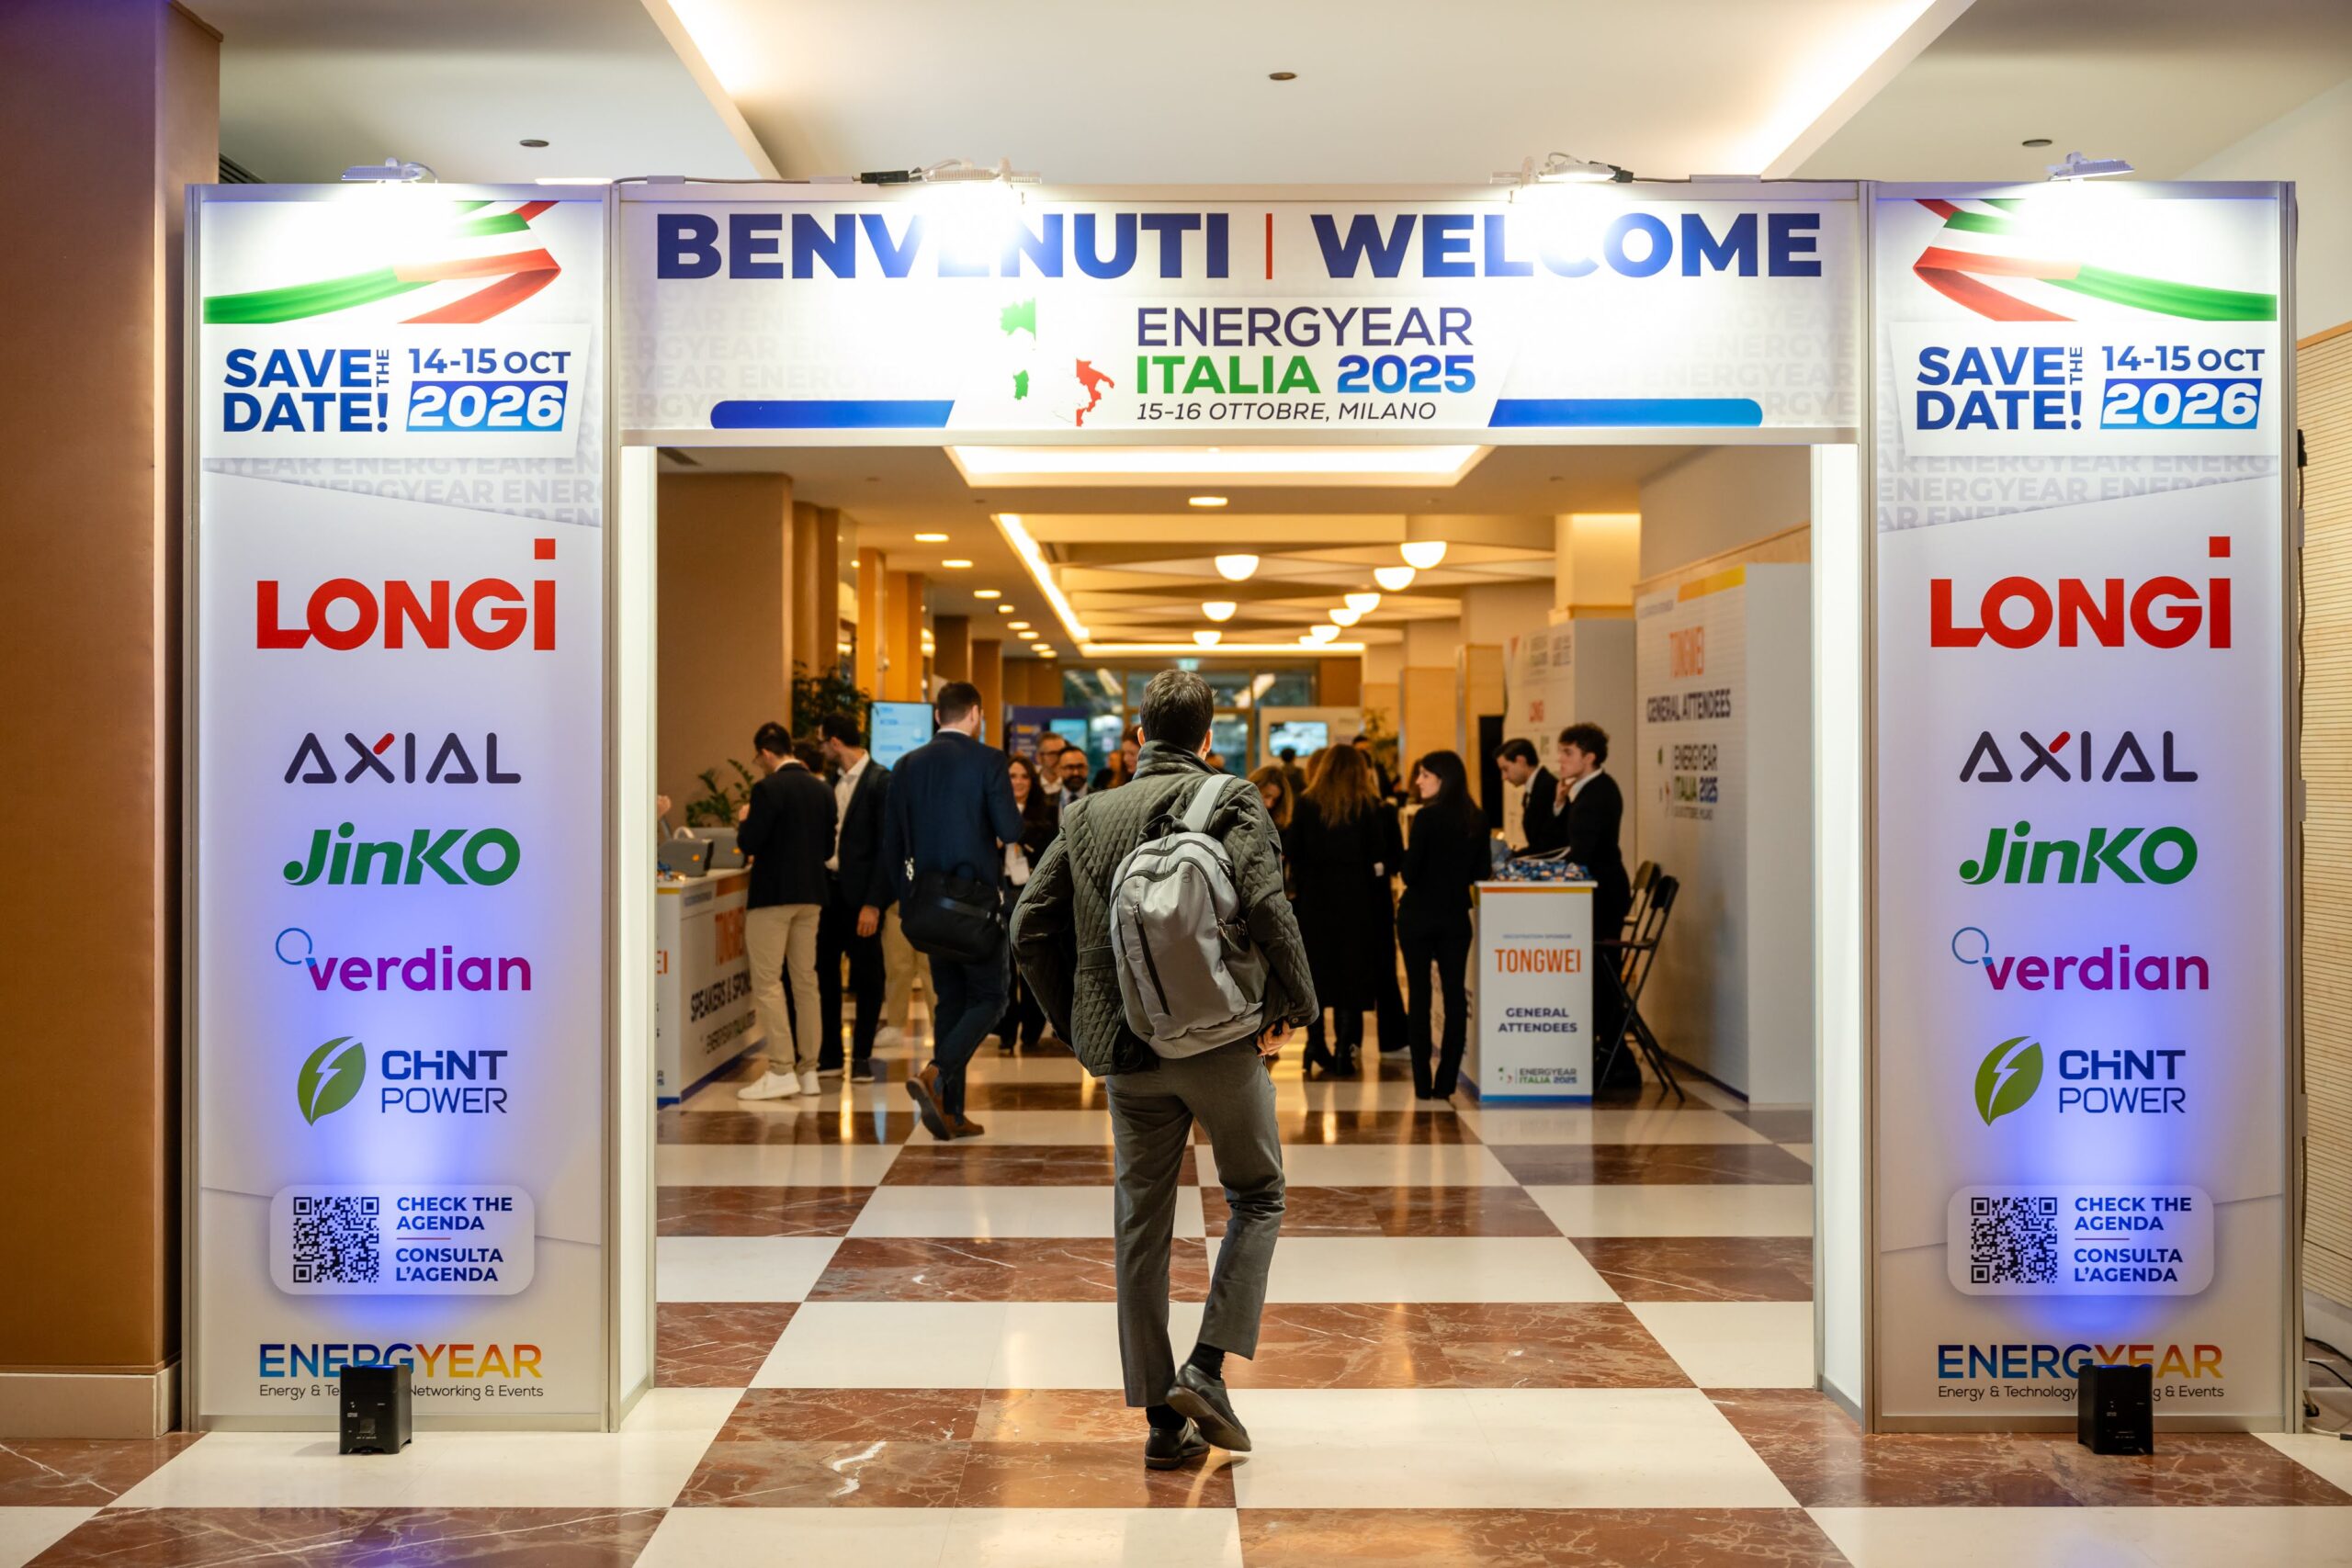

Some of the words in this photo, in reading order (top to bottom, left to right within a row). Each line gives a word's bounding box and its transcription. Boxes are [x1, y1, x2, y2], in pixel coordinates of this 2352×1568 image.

[1137, 306, 1474, 347] ENERGYEAR
[223, 348, 372, 388] SAVE
[376, 349, 390, 388] THE
[408, 347, 497, 374] 14-15
[503, 351, 571, 374] OCT
[1917, 346, 2065, 386] SAVE
[2070, 346, 2083, 384] THE
[2101, 345, 2190, 371] 14-15
[2198, 348, 2265, 371] OCT
[1136, 355, 1320, 394] ITALIA
[1338, 355, 1476, 394] 2025
[223, 392, 389, 433] DATE!
[408, 385, 563, 427] 2026
[1137, 402, 1201, 420] 15-16
[1209, 402, 1329, 423] OTTOBRE,
[1339, 402, 1436, 420] MILANO
[1916, 390, 2082, 430] DATE!
[2102, 382, 2258, 424] 2026
[1683, 689, 1731, 720] ATTENDEES
[284, 732, 521, 784] AXIAL
[1959, 731, 2199, 783] AXIAL
[306, 946, 531, 991] verdian
[1495, 949, 1581, 973] TONGWEI
[1982, 945, 2209, 990] verdian
[1506, 1008, 1569, 1018] GENERAL
[1498, 1022, 1577, 1032] ATTENDEES
[1519, 1067, 1577, 1077] ENERGYEAR
[381, 1088, 508, 1113] POWER
[2059, 1087, 2186, 1113] POWER
[397, 1197, 467, 1212] CHECK
[474, 1197, 513, 1212] THE
[2075, 1197, 2145, 1213] CHECK
[2152, 1197, 2192, 1212] THE
[397, 1215, 485, 1231] AGENDA
[2075, 1216, 2164, 1231] AGENDA
[396, 1248, 503, 1263] CONSULTA
[2075, 1248, 2183, 1263] CONSULTA
[260, 1343, 543, 1378] ENERGYEAR
[1938, 1344, 2223, 1379] ENERGYEAR
[260, 1385, 305, 1400] Energy
[311, 1385, 321, 1396] &
[485, 1385, 495, 1396] &
[499, 1385, 544, 1396] Events
[1939, 1386, 1984, 1401] Energy
[1990, 1386, 1999, 1397] &
[2004, 1385, 2078, 1401] Technology
[2165, 1386, 2175, 1397] &
[2179, 1386, 2224, 1397] Events
